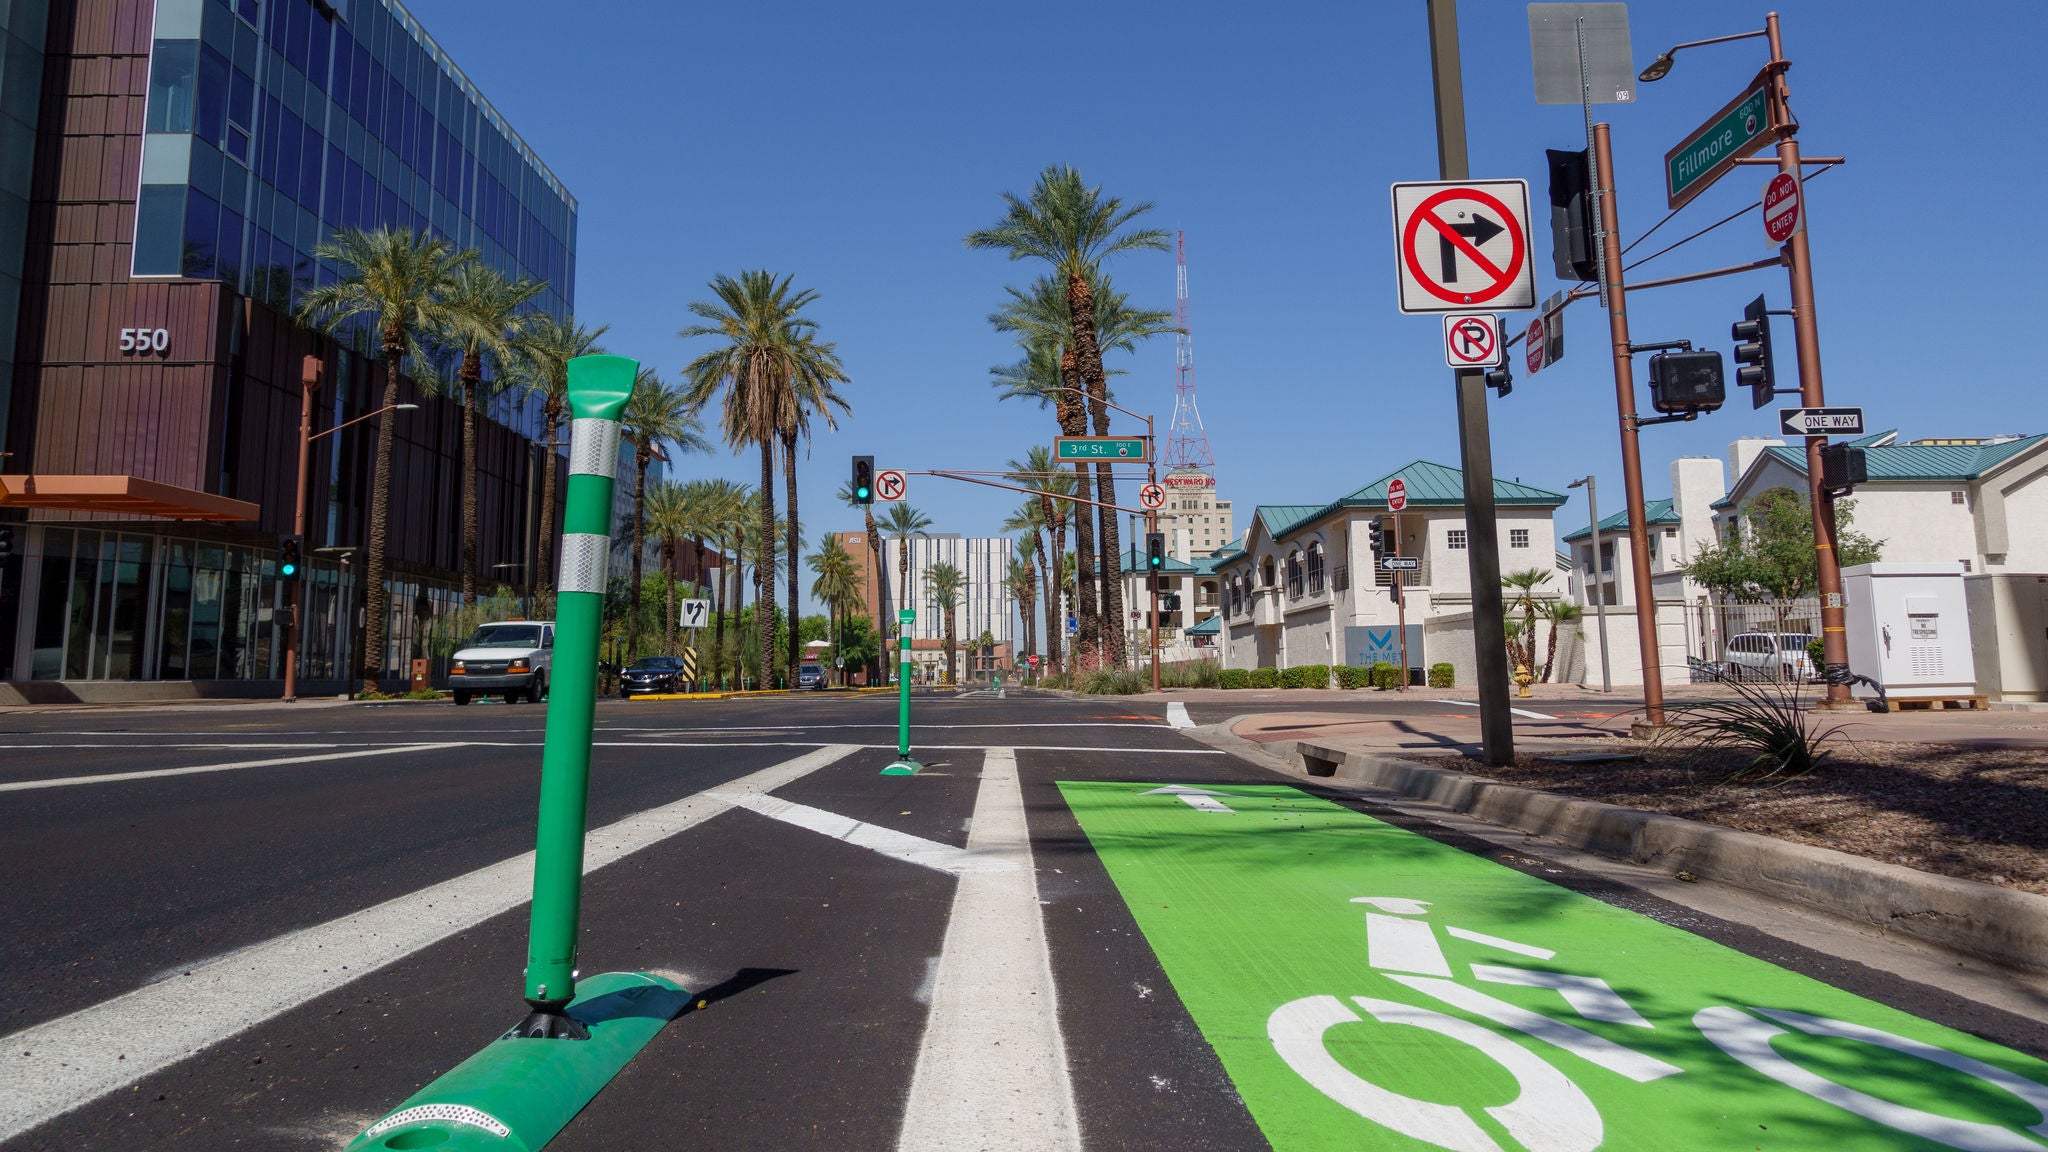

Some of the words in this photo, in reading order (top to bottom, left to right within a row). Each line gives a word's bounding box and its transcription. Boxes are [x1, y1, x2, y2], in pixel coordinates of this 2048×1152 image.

[1739, 102, 1753, 119] 600
[1754, 97, 1761, 108] N
[1678, 129, 1733, 181] Fillmore
[1767, 193, 1777, 206] DO
[1780, 180, 1793, 197] NOT
[1772, 212, 1794, 233] ENTER
[120, 328, 169, 351] 550
[1805, 416, 1828, 427] ONE
[1832, 416, 1855, 427] WAY
[1070, 444, 1087, 454] 3rd
[1091, 444, 1107, 454] St.
[1360, 652, 1378, 661] THE
